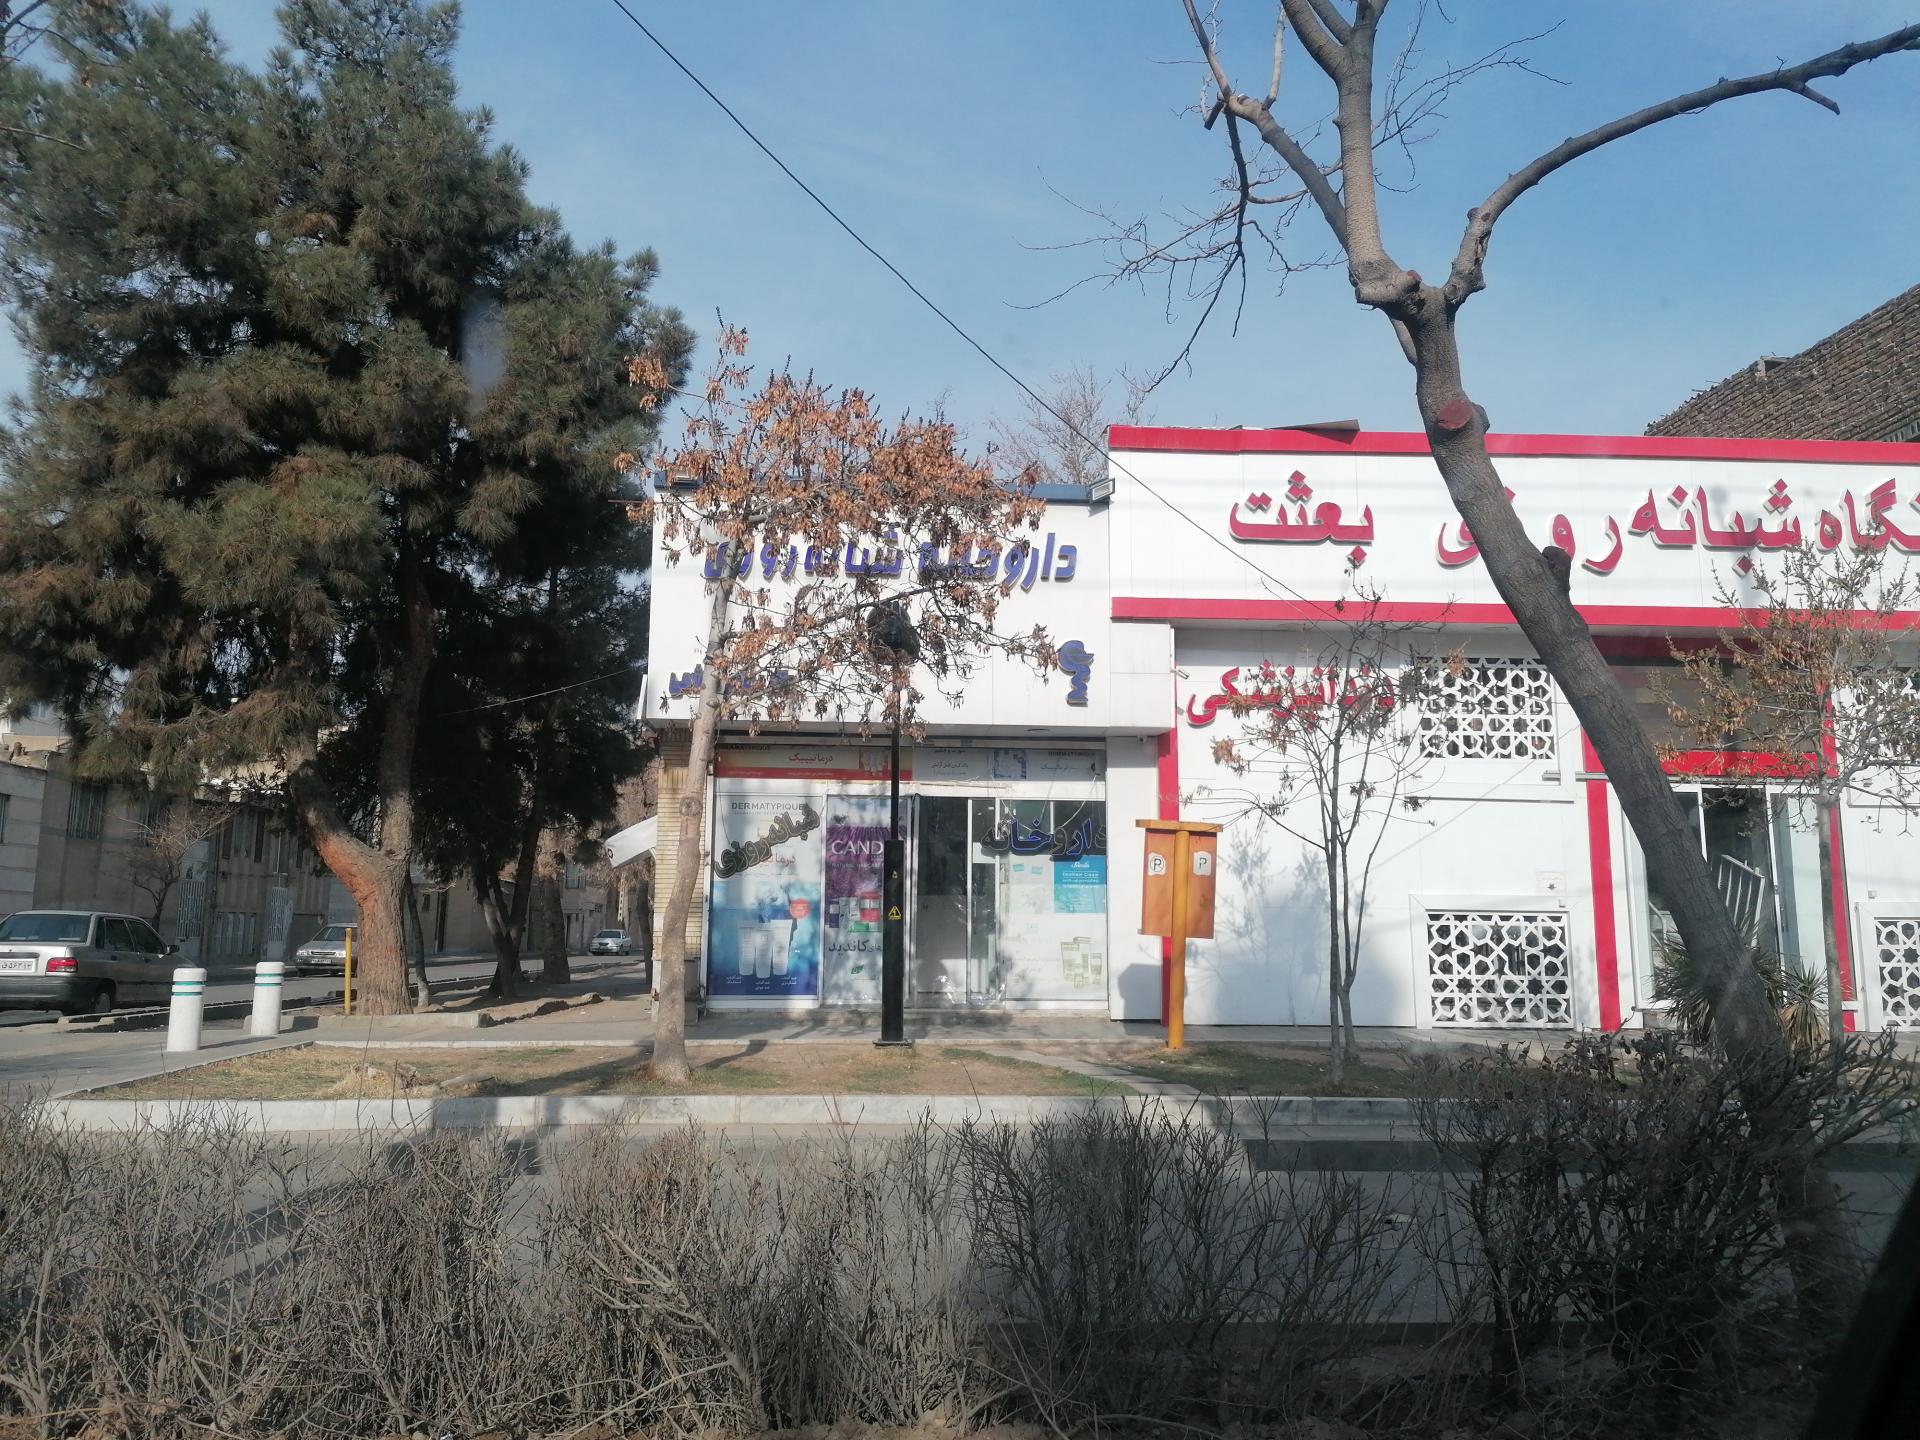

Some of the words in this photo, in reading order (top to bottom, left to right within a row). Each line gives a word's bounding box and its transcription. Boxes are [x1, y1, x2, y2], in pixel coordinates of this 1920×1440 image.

[1229, 470, 1374, 568] بعثت
[1435, 486, 1624, 575] روی
[1628, 478, 1802, 577] شبانه
[1815, 477, 1920, 554] گاه
[731, 802, 804, 811] DERMATYPIQUE
[767, 803, 821, 845] شبانه
[831, 840, 884, 855] CAND
[980, 816, 1107, 857] داروخانه
[714, 838, 774, 879] روزی
[828, 939, 869, 956] کاندید
